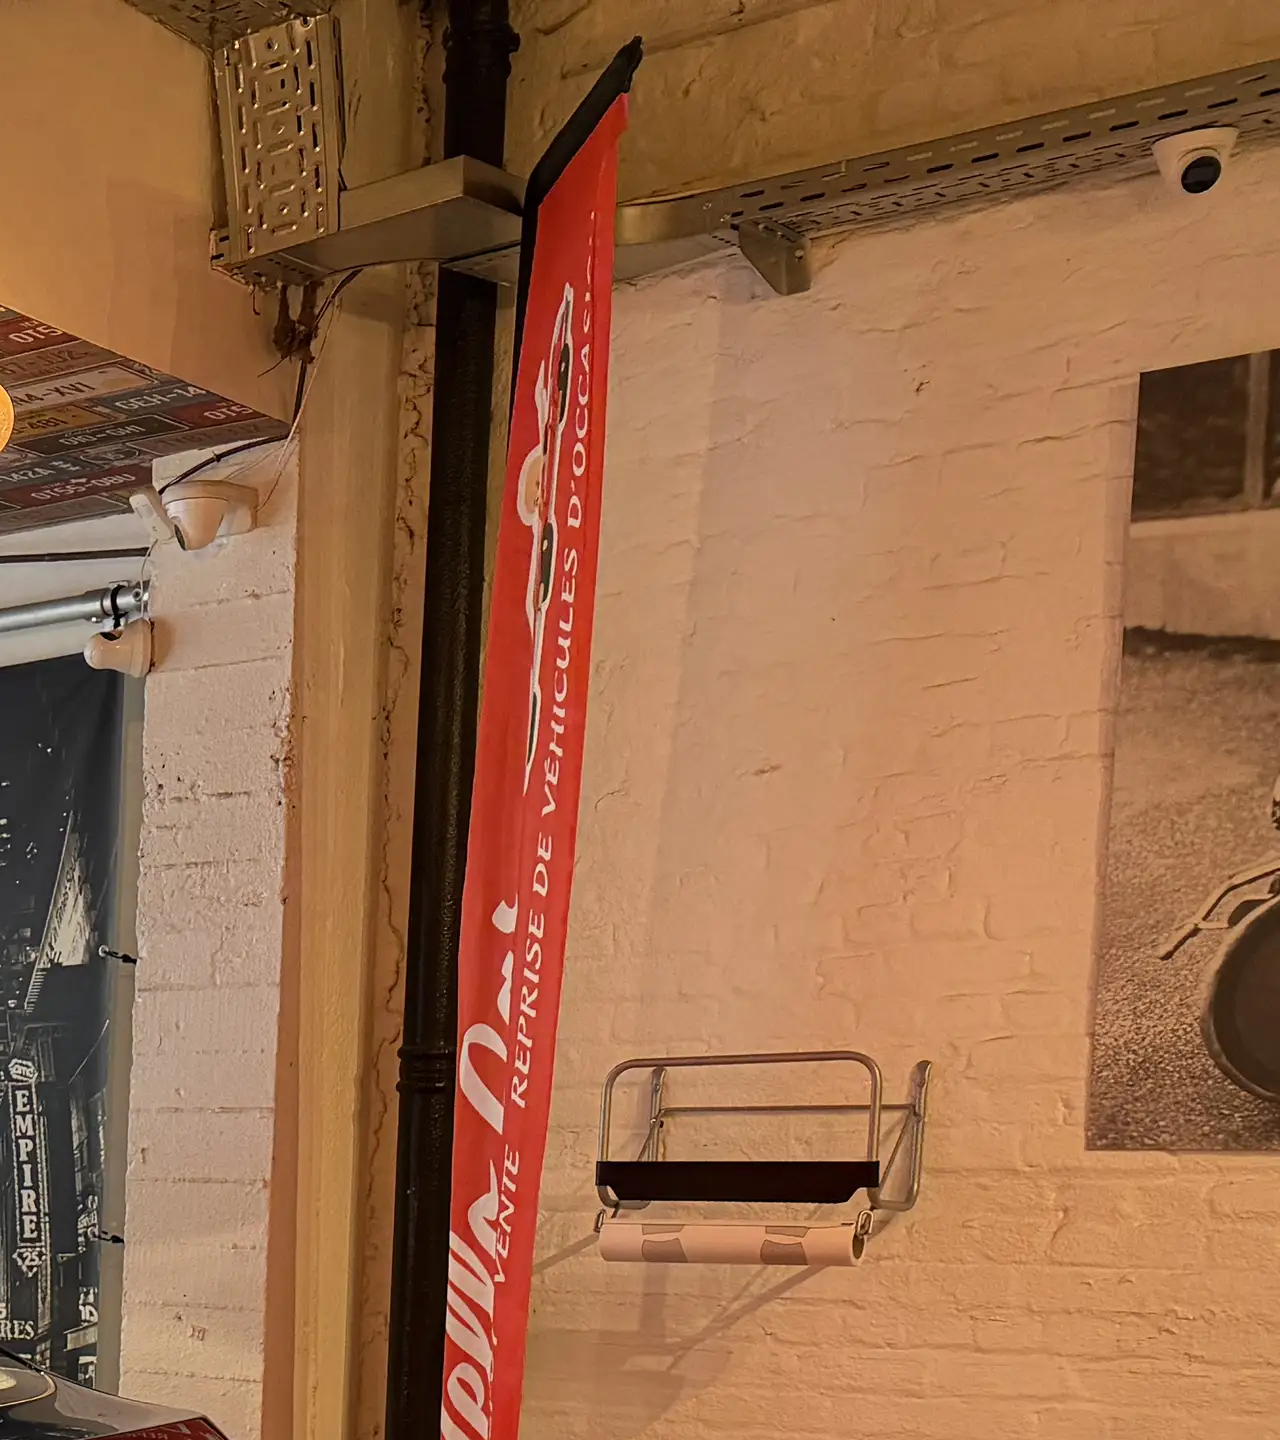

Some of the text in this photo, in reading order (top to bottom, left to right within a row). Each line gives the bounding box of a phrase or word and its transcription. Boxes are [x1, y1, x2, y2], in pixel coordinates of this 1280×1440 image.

[540, 546, 582, 822] VÉHICULES
[532, 831, 554, 898] DE
[510, 906, 547, 1110] REPRISE
[13, 1088, 39, 1241] EMPIRE
[493, 1143, 522, 1286] VENTE
